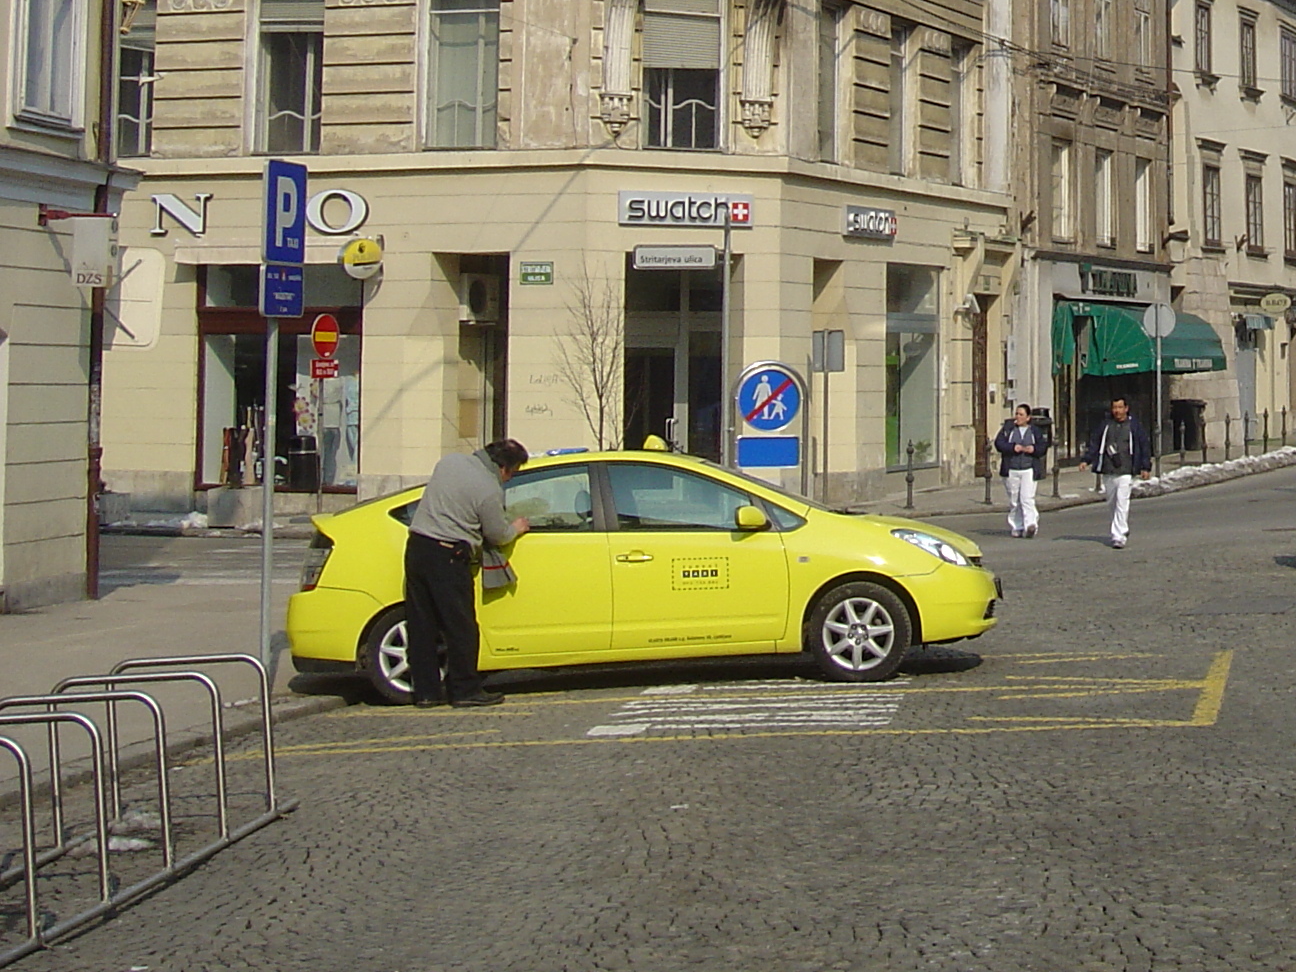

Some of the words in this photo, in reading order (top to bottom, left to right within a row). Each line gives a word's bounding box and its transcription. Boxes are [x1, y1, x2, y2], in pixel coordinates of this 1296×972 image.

[276, 176, 297, 247] P
[627, 196, 731, 222] swatch
[848, 212, 891, 233] swatch
[640, 254, 682, 265] Stritarjeva
[684, 255, 703, 264] ulica
[76, 272, 102, 285] DZS
